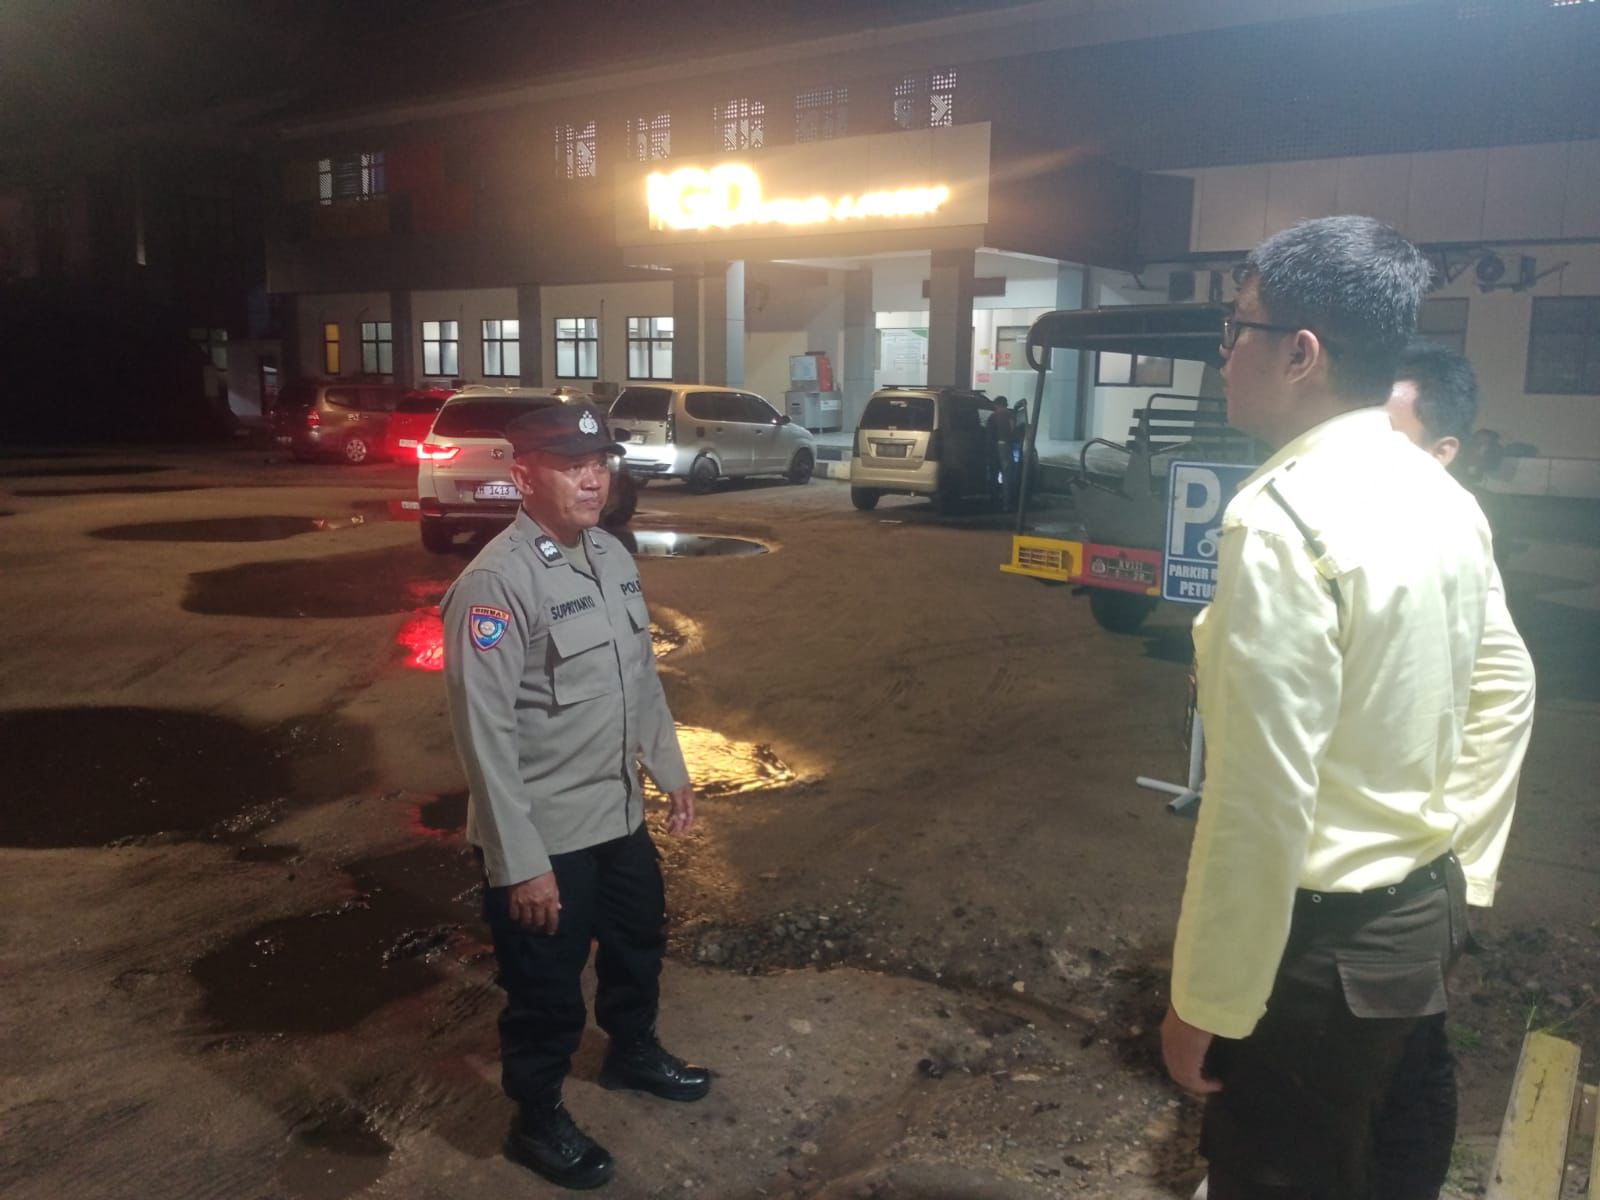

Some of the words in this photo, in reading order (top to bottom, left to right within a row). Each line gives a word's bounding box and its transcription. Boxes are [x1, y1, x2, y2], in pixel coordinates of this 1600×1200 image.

[1170, 466, 1221, 555] P
[1168, 564, 1209, 580] PARKIR
[551, 595, 595, 620] SUPRIYANTO
